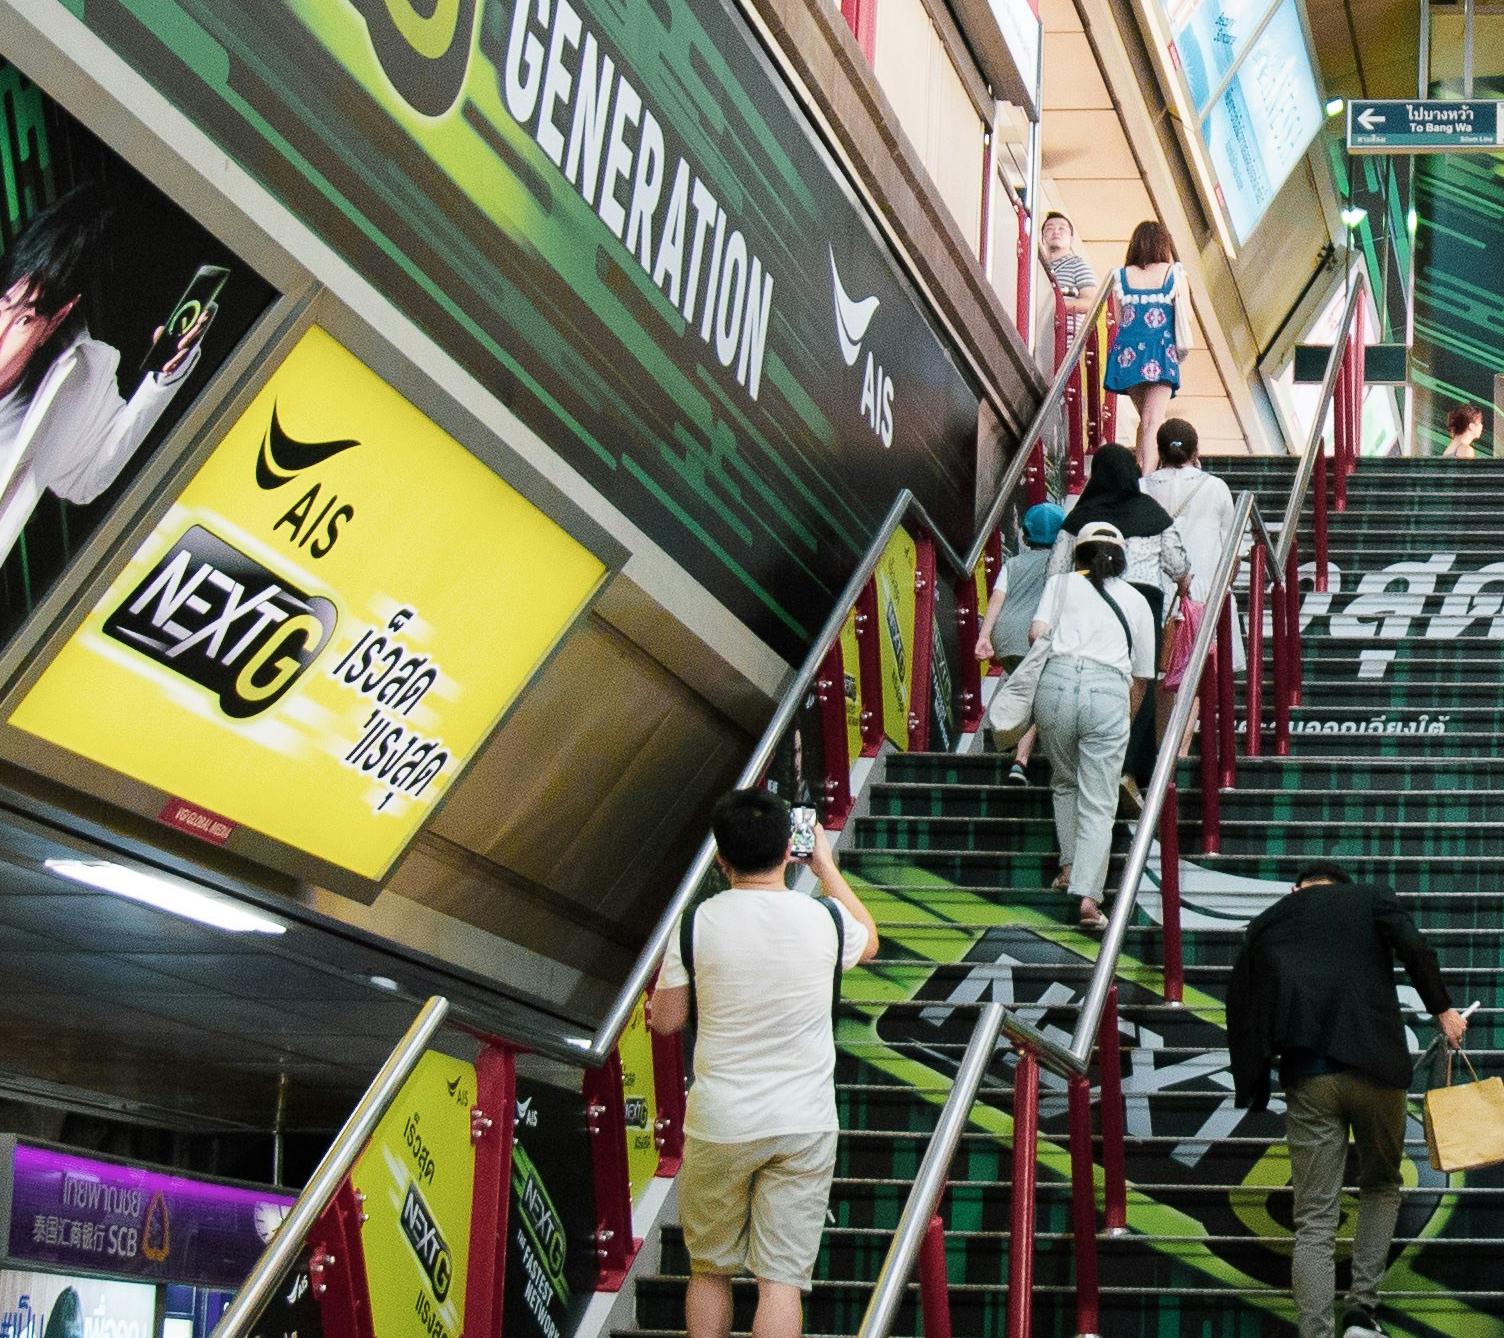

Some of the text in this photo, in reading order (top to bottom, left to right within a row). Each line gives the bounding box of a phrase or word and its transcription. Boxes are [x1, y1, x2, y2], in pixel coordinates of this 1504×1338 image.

[1409, 123, 1473, 134] To Bang Wa
[859, 373, 894, 449] AIS
[274, 483, 354, 558] AIS
[526, 1110, 538, 1128] AIS
[107, 1223, 139, 1257] SCB
[522, 1249, 555, 1308] FASTEST
